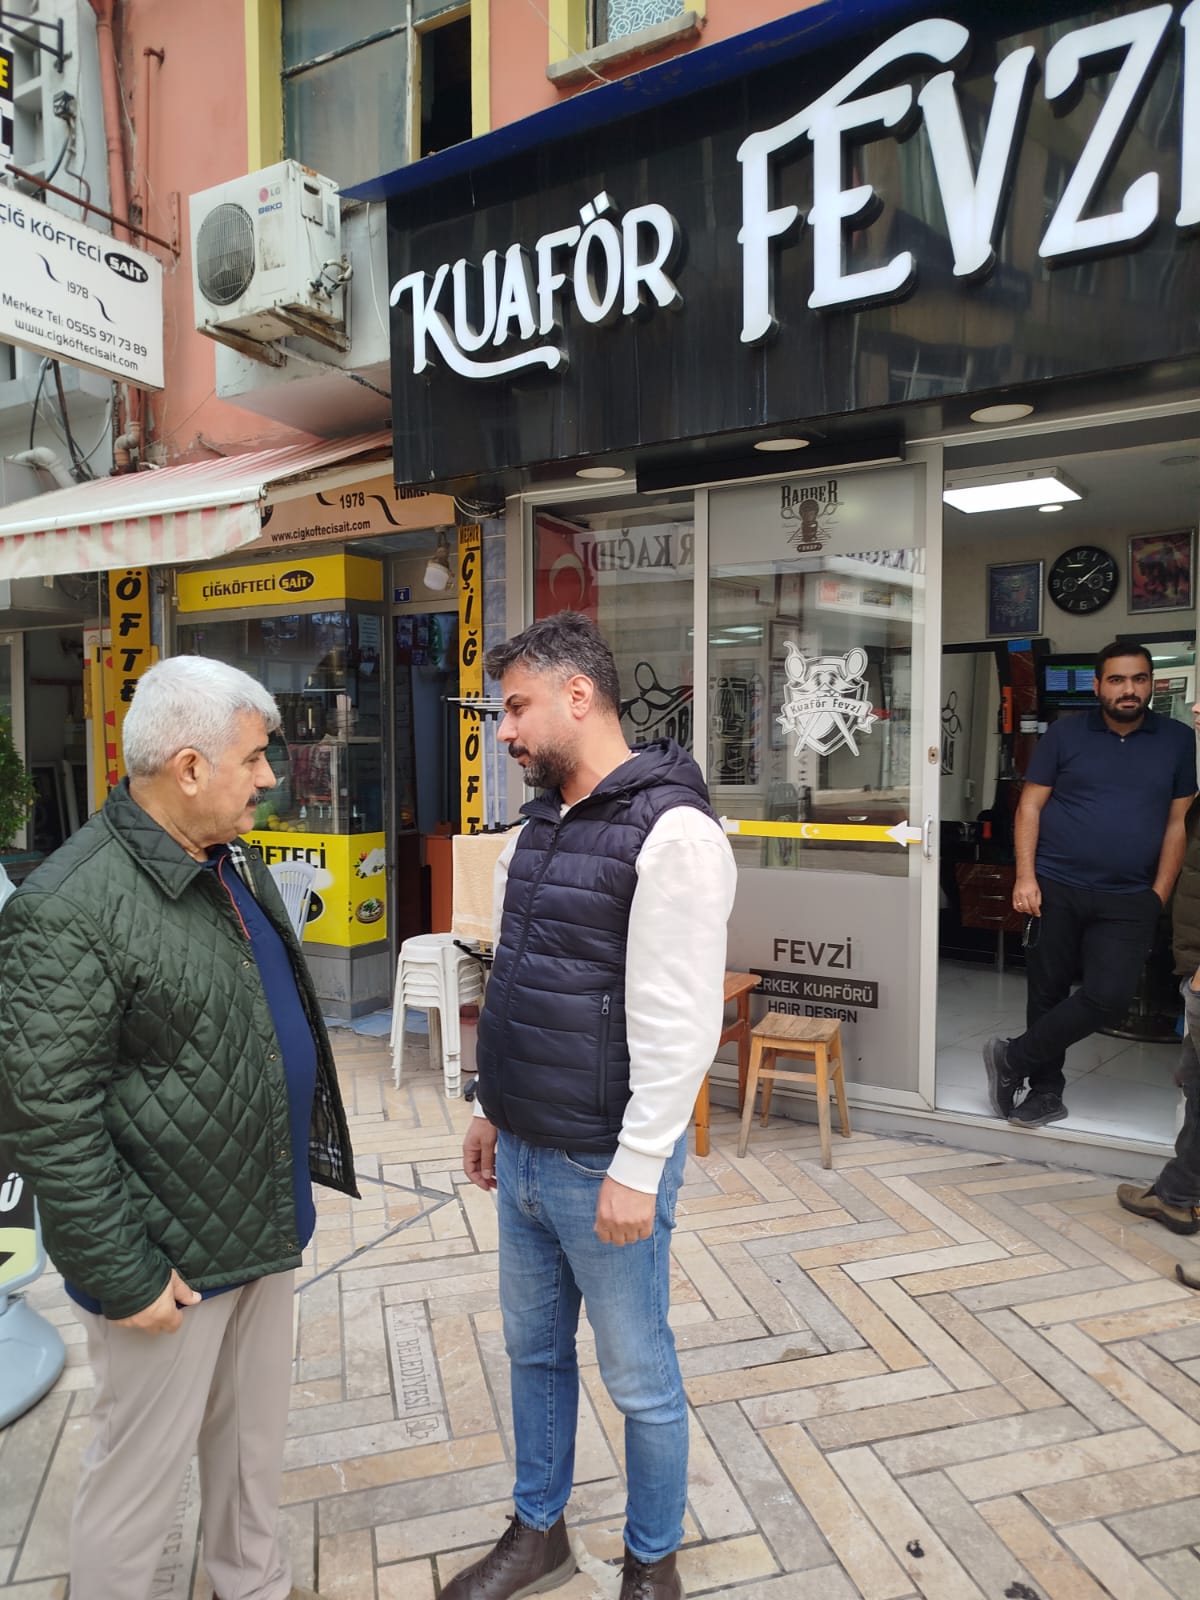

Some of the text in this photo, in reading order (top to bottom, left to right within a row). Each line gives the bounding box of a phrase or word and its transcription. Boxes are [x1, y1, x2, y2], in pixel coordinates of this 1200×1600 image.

[258, 202, 282, 215] BEKO
[30, 217, 101, 263] KÖFTECİ
[109, 256, 144, 281] SAİT
[67, 281, 89, 299] 1978
[390, 190, 678, 378] KUAFÖR
[66, 318, 97, 338] 0555
[99, 329, 116, 346] 971
[118, 337, 131, 352] 73
[133, 344, 148, 357] 89
[339, 492, 365, 509] 1978
[781, 480, 837, 508] BARBER
[271, 519, 371, 543] www.cigkoftecisait.com
[203, 574, 276, 601] ÇİĞKÖFTECİ
[774, 937, 851, 969] FEVZİ
[803, 984, 872, 1003] KUAFÖRÜ
